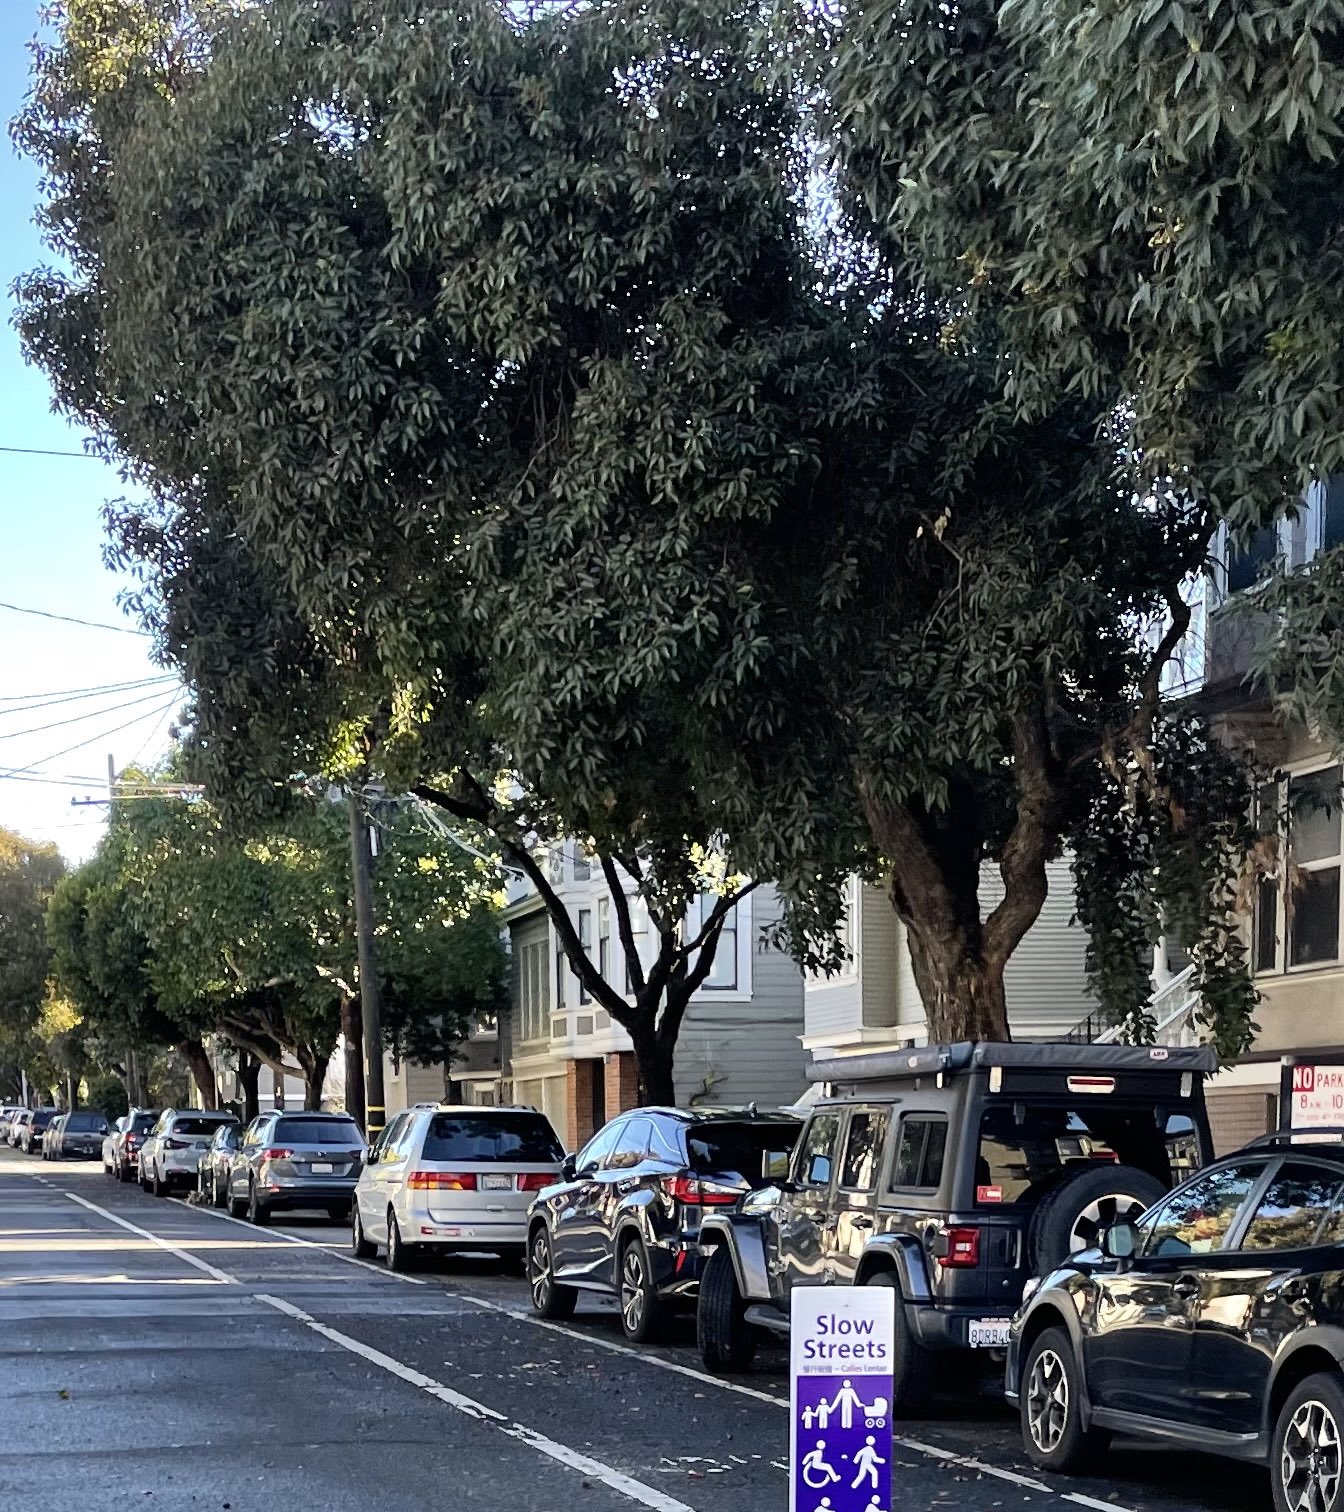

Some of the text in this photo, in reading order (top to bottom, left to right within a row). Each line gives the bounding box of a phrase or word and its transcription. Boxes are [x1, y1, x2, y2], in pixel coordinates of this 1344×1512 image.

[1293, 1067, 1313, 1089] NO
[1301, 1094, 1307, 1109] 8
[1332, 1094, 1343, 1109] 10
[816, 1314, 875, 1335] Slow
[803, 1339, 887, 1359] Streets
